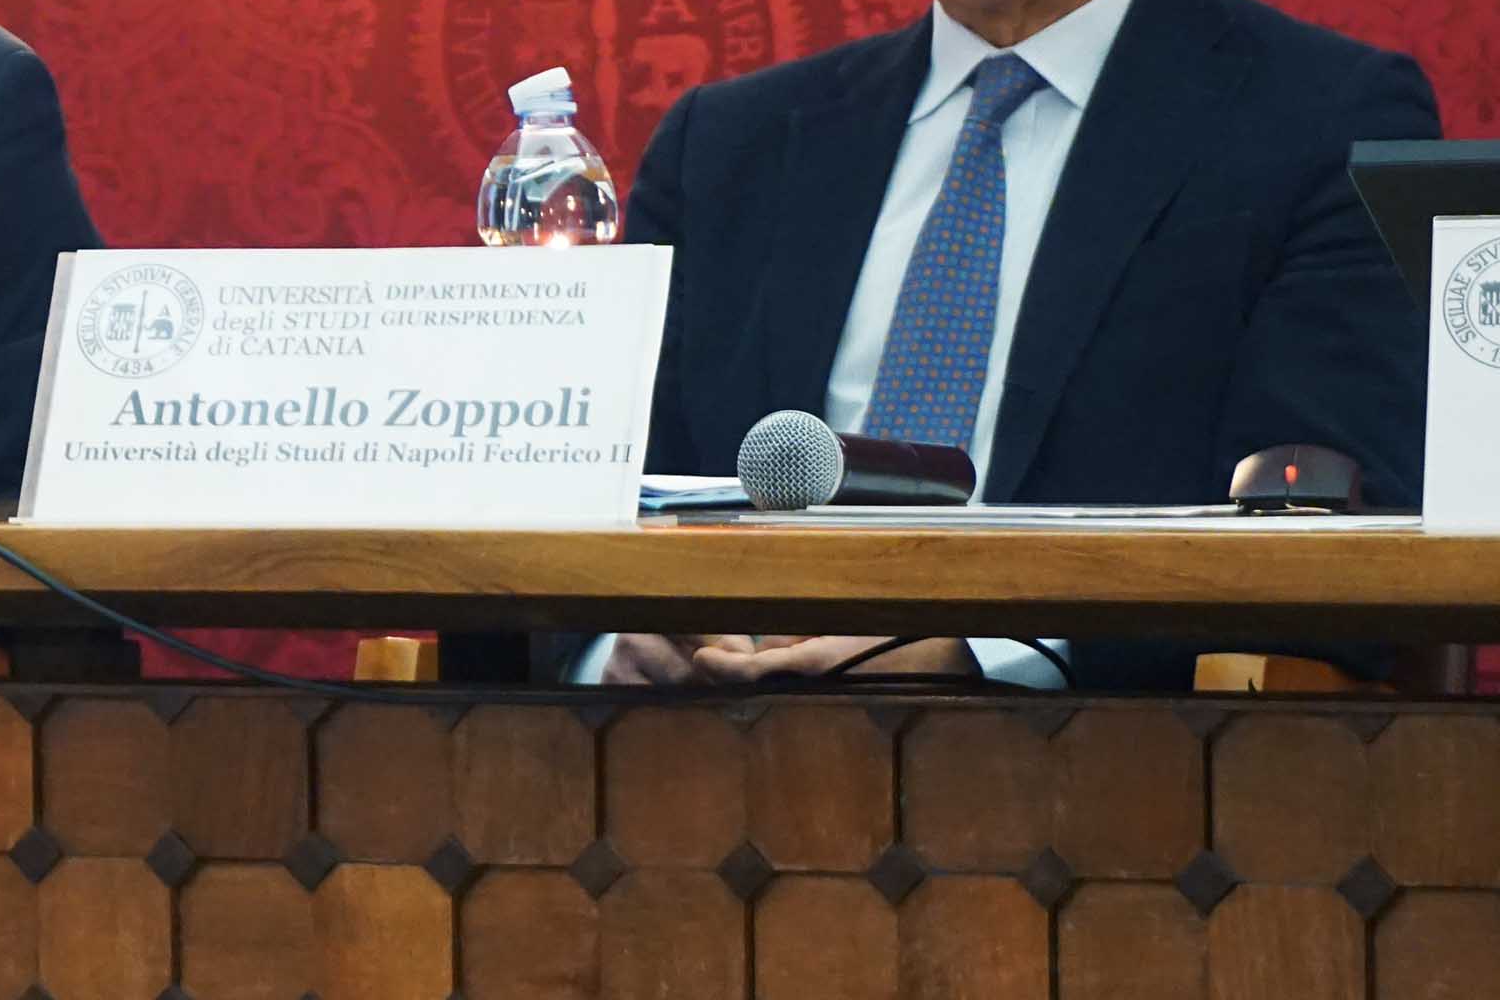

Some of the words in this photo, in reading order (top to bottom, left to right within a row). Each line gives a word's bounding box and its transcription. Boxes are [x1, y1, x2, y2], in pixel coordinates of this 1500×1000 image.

[218, 280, 374, 305] UNIVERSITÀ
[386, 283, 561, 300] DIPARTIMENTO
[566, 282, 587, 298] di
[1448, 272, 1477, 344] SICILIAE
[1466, 242, 1500, 273] STV
[212, 310, 274, 337] degli
[283, 311, 371, 330] STUDI
[381, 310, 586, 326] GIURISPRUDENZA
[208, 336, 232, 356] di
[240, 336, 365, 356] CATANIA
[108, 387, 369, 427] Antonello
[382, 385, 592, 438] Zoppoli
[63, 441, 196, 462] Università
[204, 441, 268, 467] degli
[275, 441, 346, 462] Studi
[353, 441, 380, 462] di
[386, 441, 475, 468] Napoli
[483, 440, 601, 463] Federico
[609, 443, 633, 463] II
